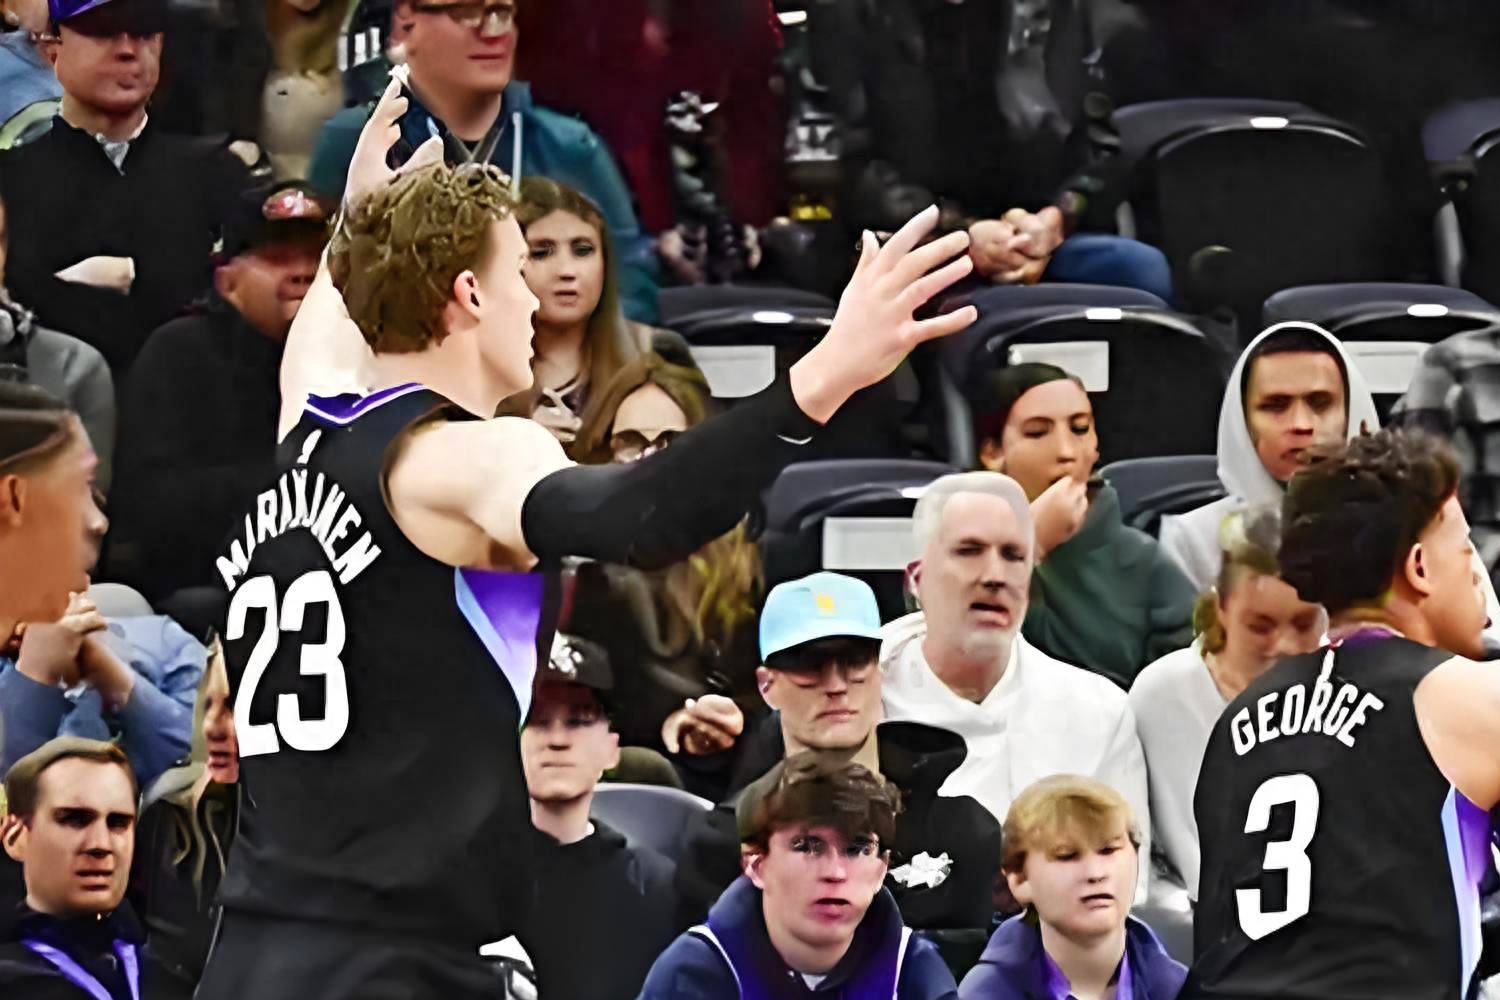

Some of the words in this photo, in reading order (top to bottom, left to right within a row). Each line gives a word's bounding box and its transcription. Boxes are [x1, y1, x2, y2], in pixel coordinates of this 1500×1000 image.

[226, 570, 350, 758] 23
[1231, 682, 1385, 756] GEORGE
[1235, 773, 1320, 941] 3
